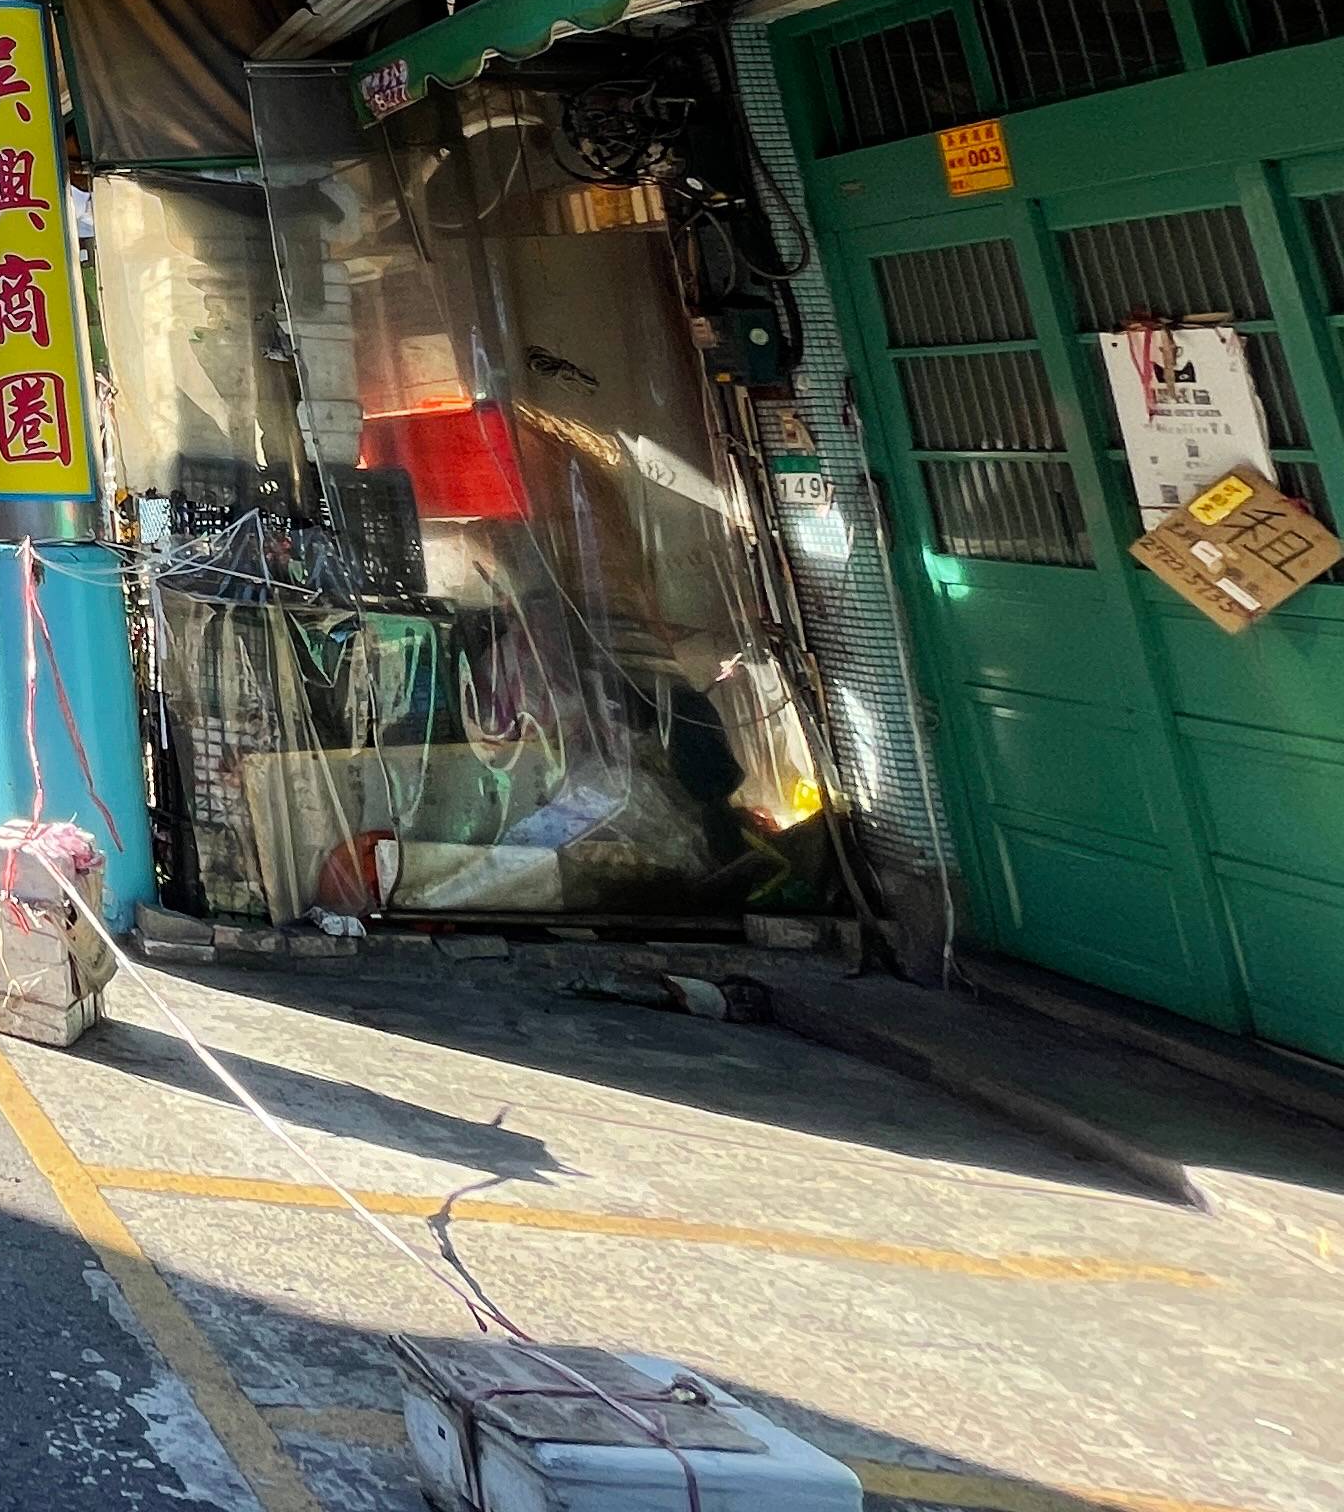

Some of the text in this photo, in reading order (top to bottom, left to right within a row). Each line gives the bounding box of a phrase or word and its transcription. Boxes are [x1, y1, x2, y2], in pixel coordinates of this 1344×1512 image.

[968, 146, 1002, 167] 003
[780, 477, 822, 499] 149
[1222, 508, 1314, 584] 租
